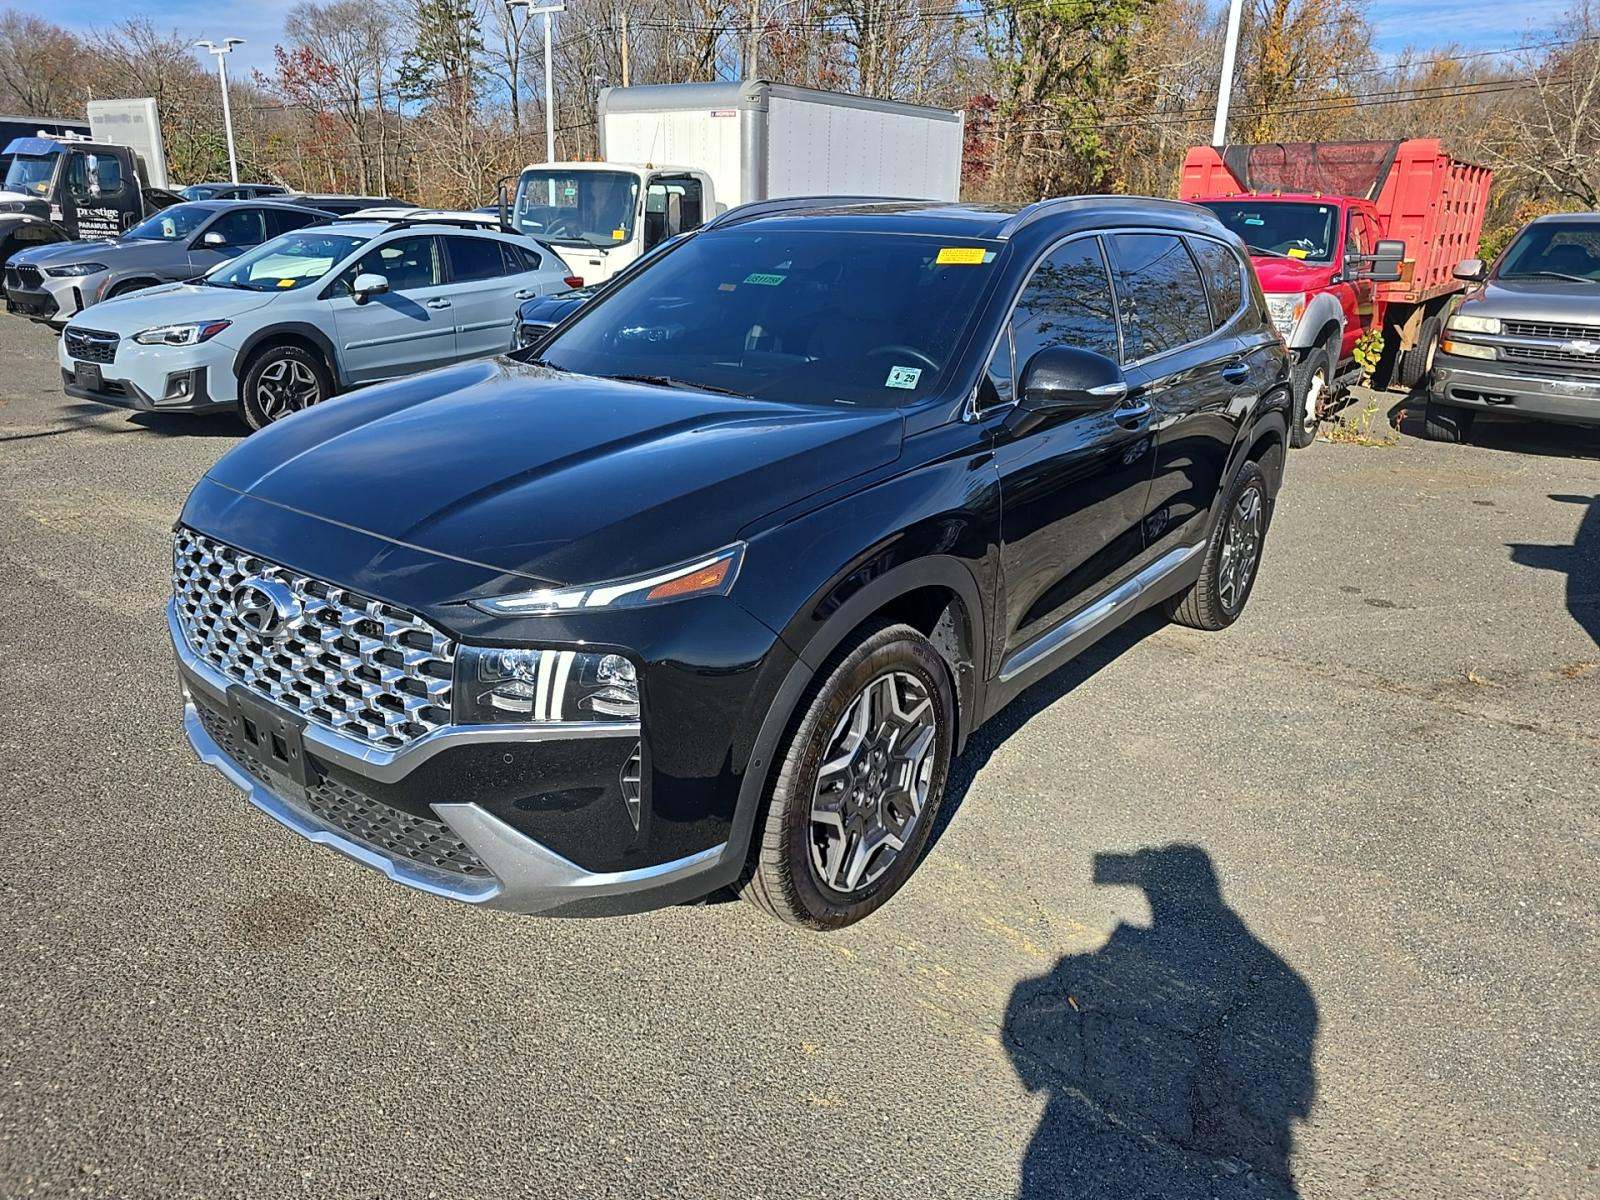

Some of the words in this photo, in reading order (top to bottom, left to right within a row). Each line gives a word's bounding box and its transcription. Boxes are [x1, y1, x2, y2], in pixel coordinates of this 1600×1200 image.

[76, 207, 119, 219] prestige
[78, 222, 109, 230] PARAMUS,
[894, 372, 900, 380] 4
[904, 374, 916, 382] 29
